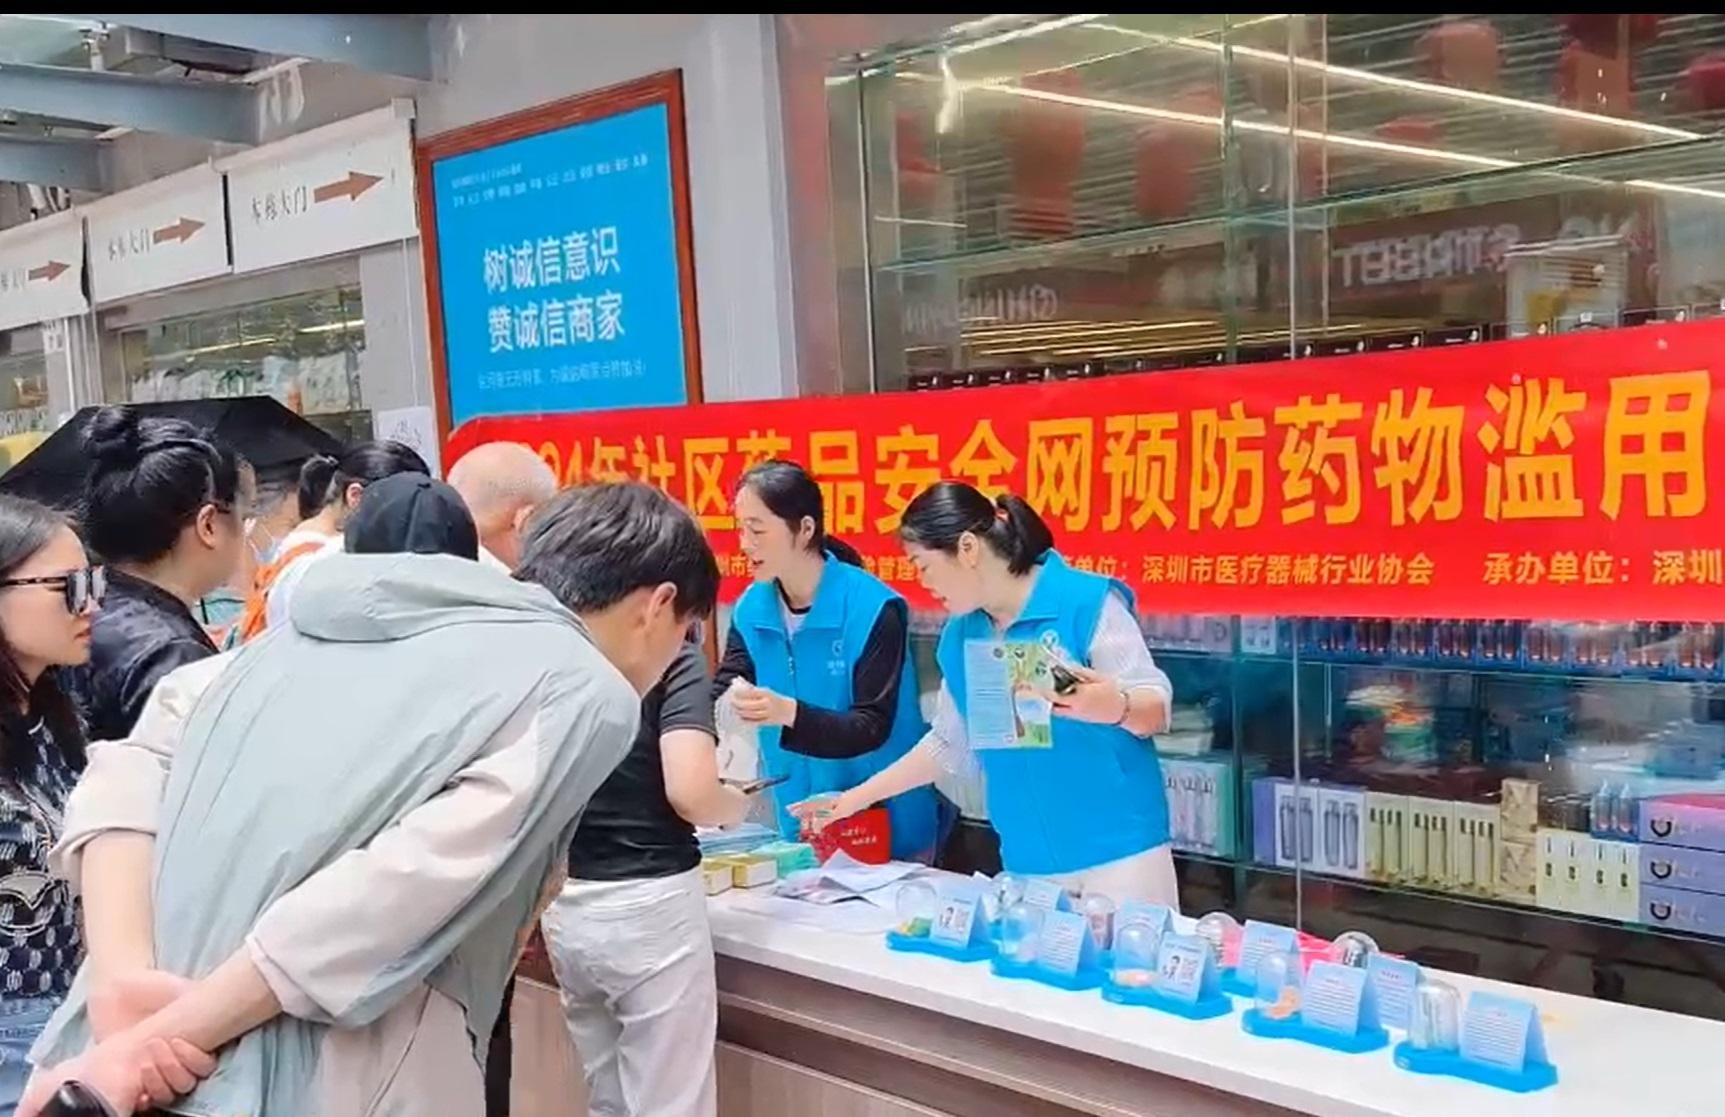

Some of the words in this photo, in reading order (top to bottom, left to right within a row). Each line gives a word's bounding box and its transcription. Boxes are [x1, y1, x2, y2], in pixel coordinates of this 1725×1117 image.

[483, 226, 621, 295] 树诚信意识
[488, 289, 625, 354] 赞诚信商家
[1064, 553, 1435, 586] 单位：深圳市医疗器械行业协会
[1483, 549, 1723, 586] 承办单位：深圳
